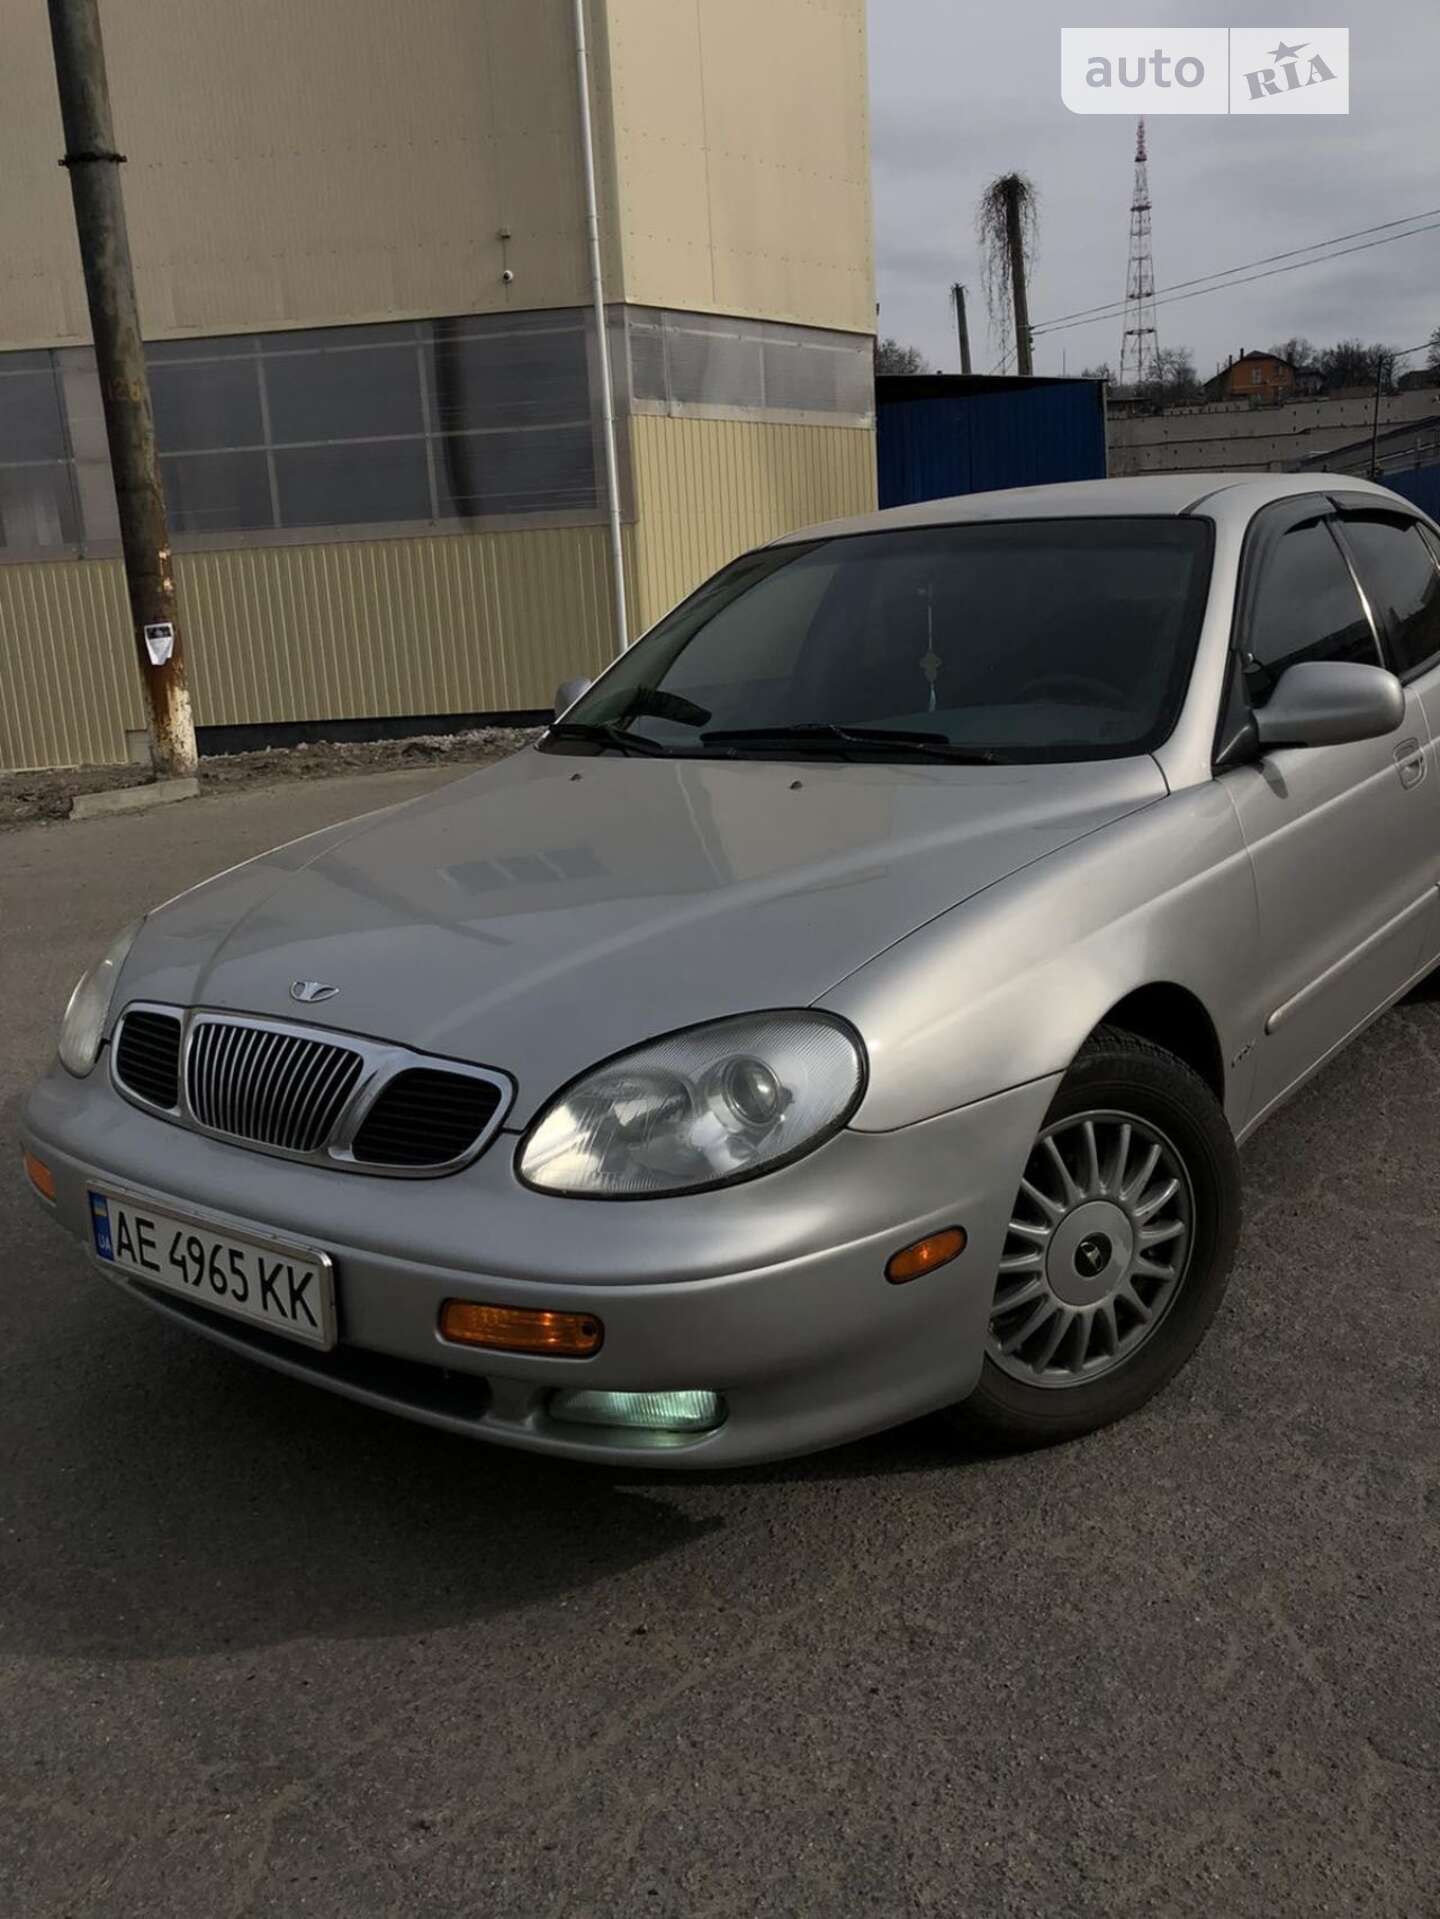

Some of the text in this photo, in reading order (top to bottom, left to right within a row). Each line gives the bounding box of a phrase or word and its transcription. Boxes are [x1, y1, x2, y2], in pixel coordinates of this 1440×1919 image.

[117, 1211, 318, 1327] AE 4965 KK
